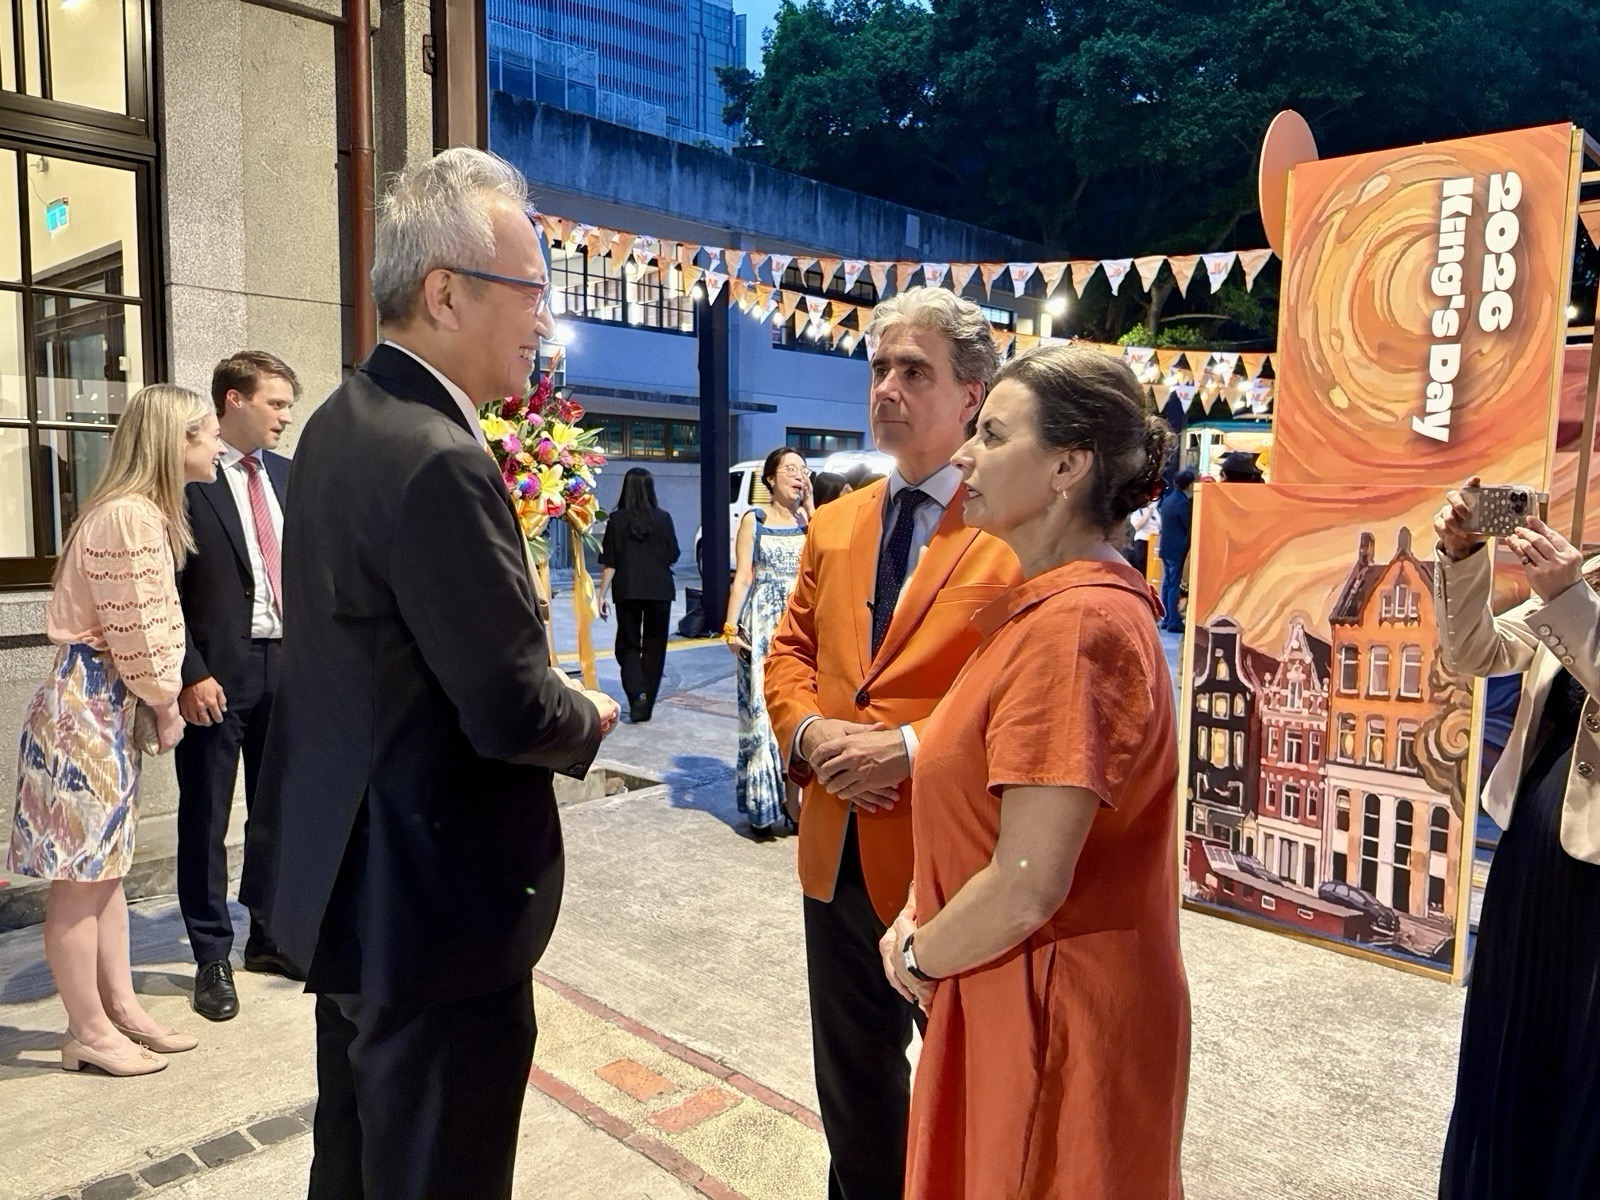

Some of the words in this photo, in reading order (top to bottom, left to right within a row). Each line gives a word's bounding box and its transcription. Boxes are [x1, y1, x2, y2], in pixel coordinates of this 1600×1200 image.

[1430, 177, 1474, 338] King's
[1478, 171, 1523, 333] 2026
[1411, 343, 1462, 443] Day
